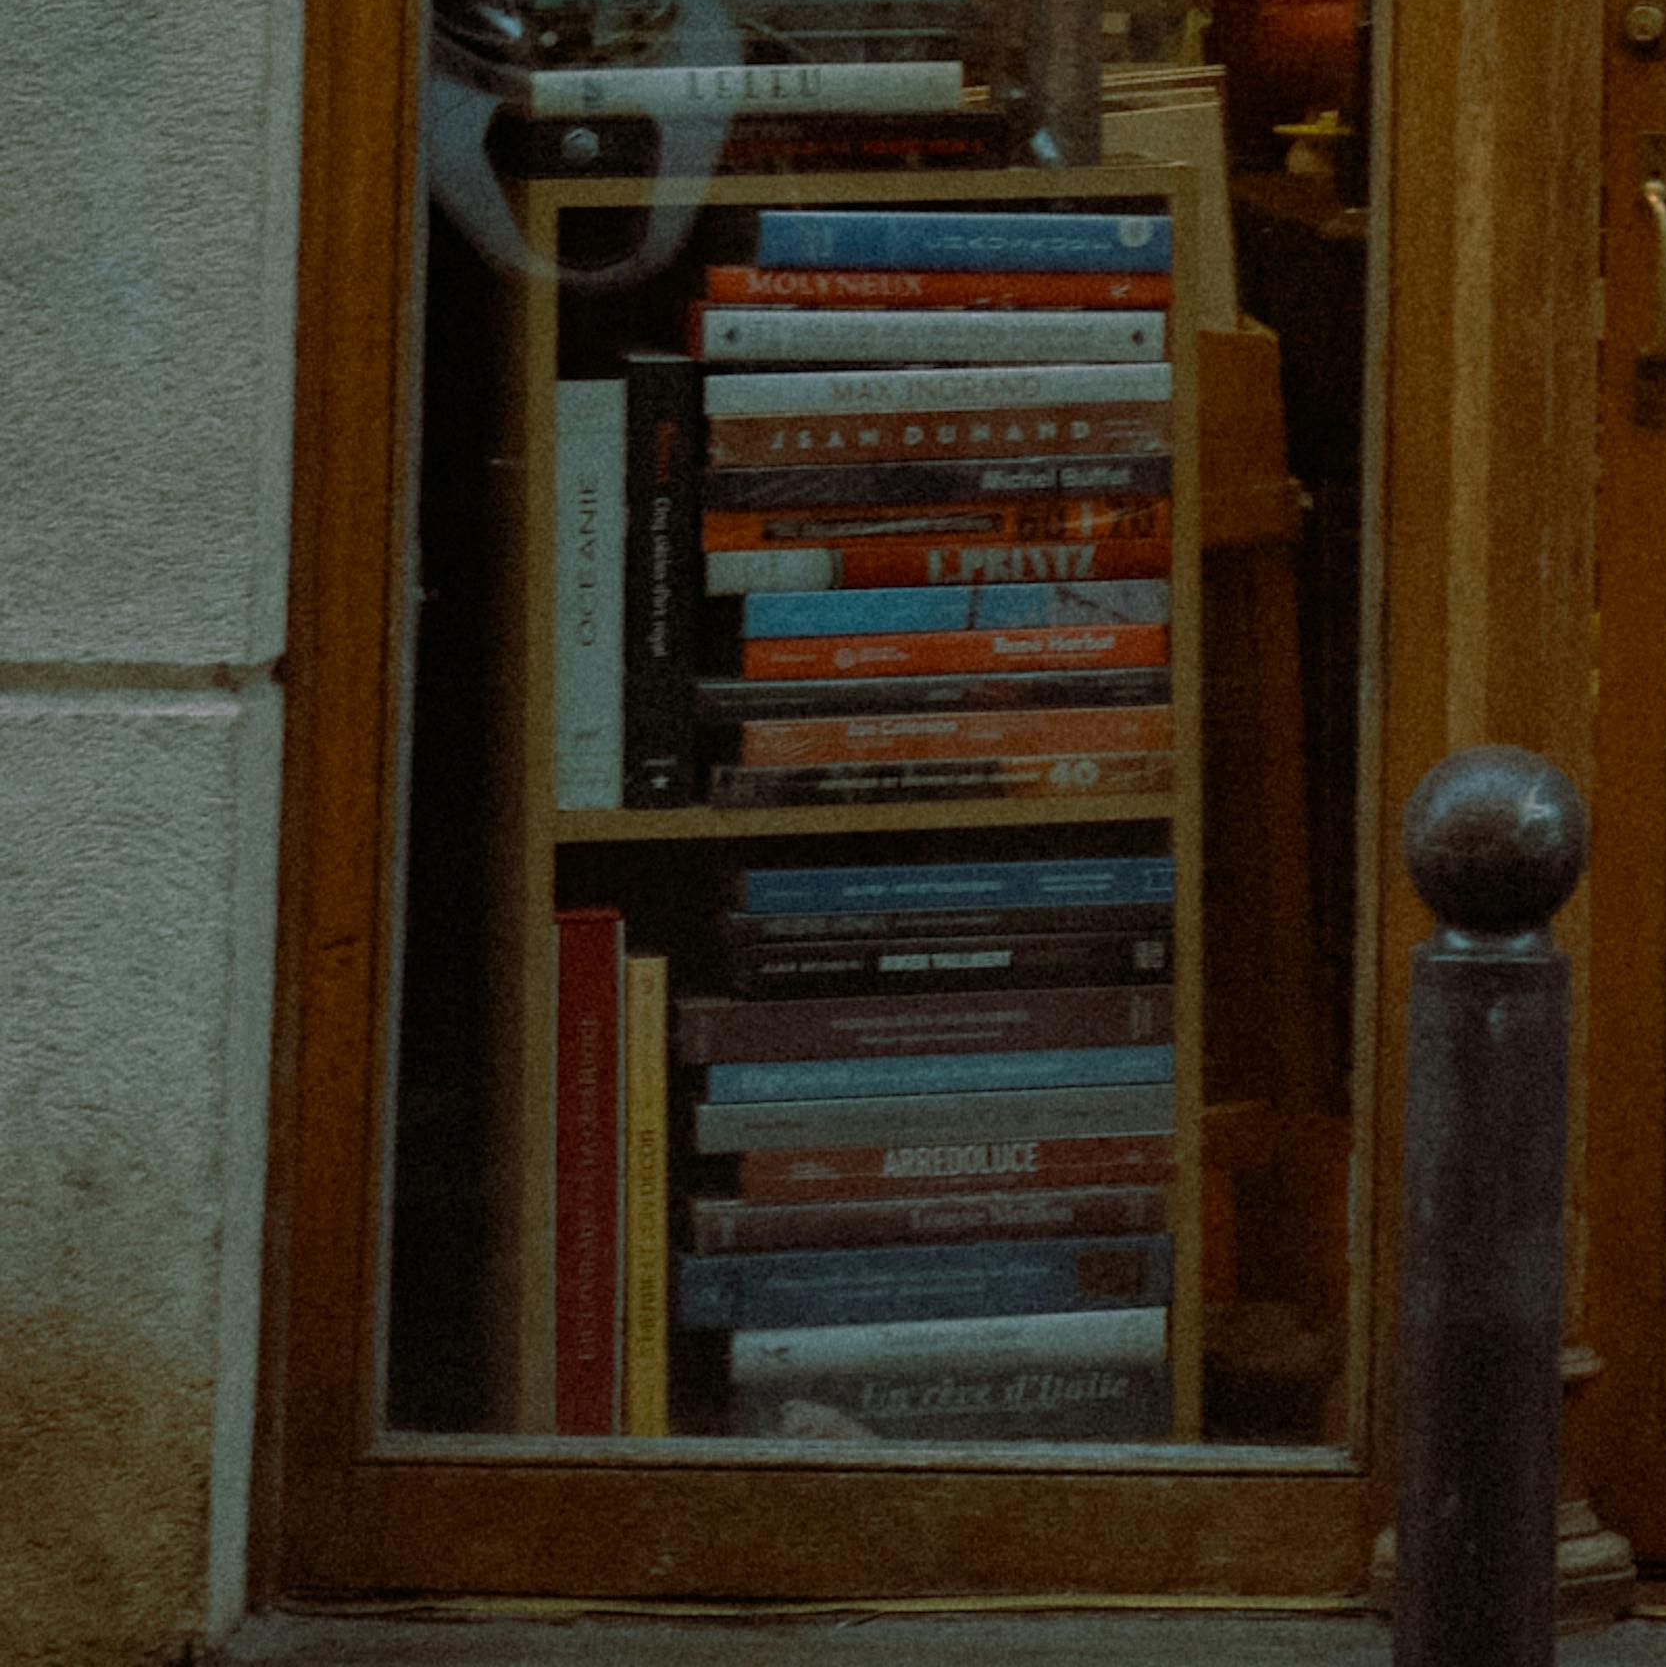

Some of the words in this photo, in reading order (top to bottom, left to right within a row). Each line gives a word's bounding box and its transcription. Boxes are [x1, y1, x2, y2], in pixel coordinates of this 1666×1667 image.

[746, 274, 923, 297] MOLYNEUX
[832, 377, 889, 402] MAX
[906, 374, 1042, 400] INGRAND
[770, 427, 879, 451] JEAN
[904, 419, 1092, 447] DUNAND
[882, 1142, 1040, 1177] ARREDOLUCE
